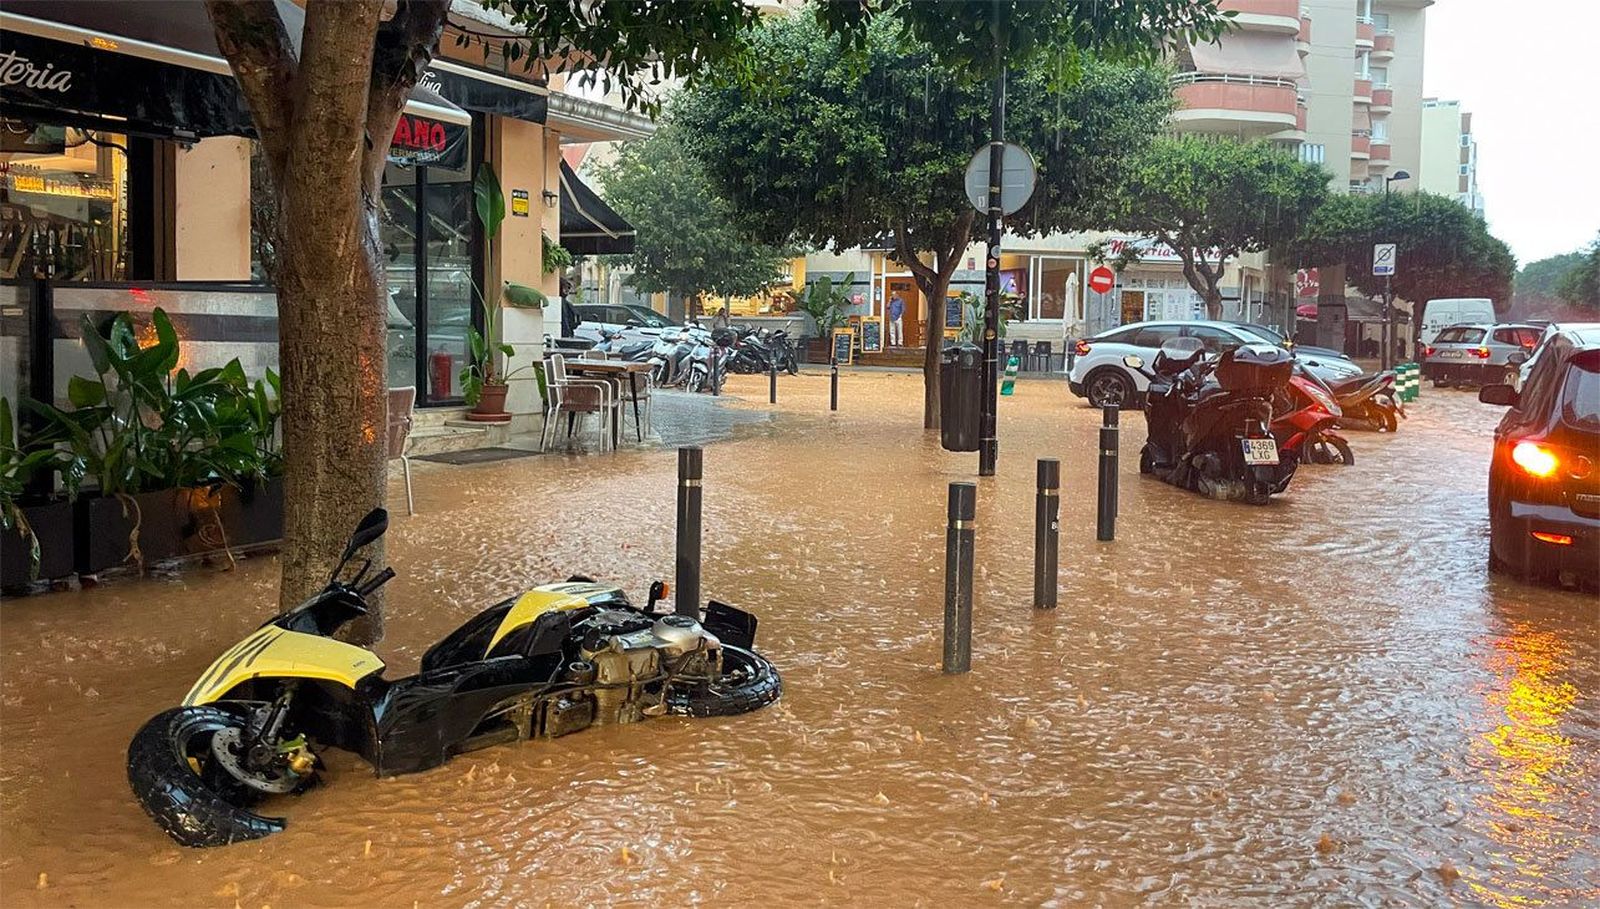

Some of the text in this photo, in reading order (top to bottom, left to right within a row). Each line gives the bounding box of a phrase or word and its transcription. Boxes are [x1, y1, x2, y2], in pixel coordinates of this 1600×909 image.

[391, 116, 447, 152] ANO
[1251, 441, 1274, 450] 4369
[1252, 451, 1271, 460] LXG
